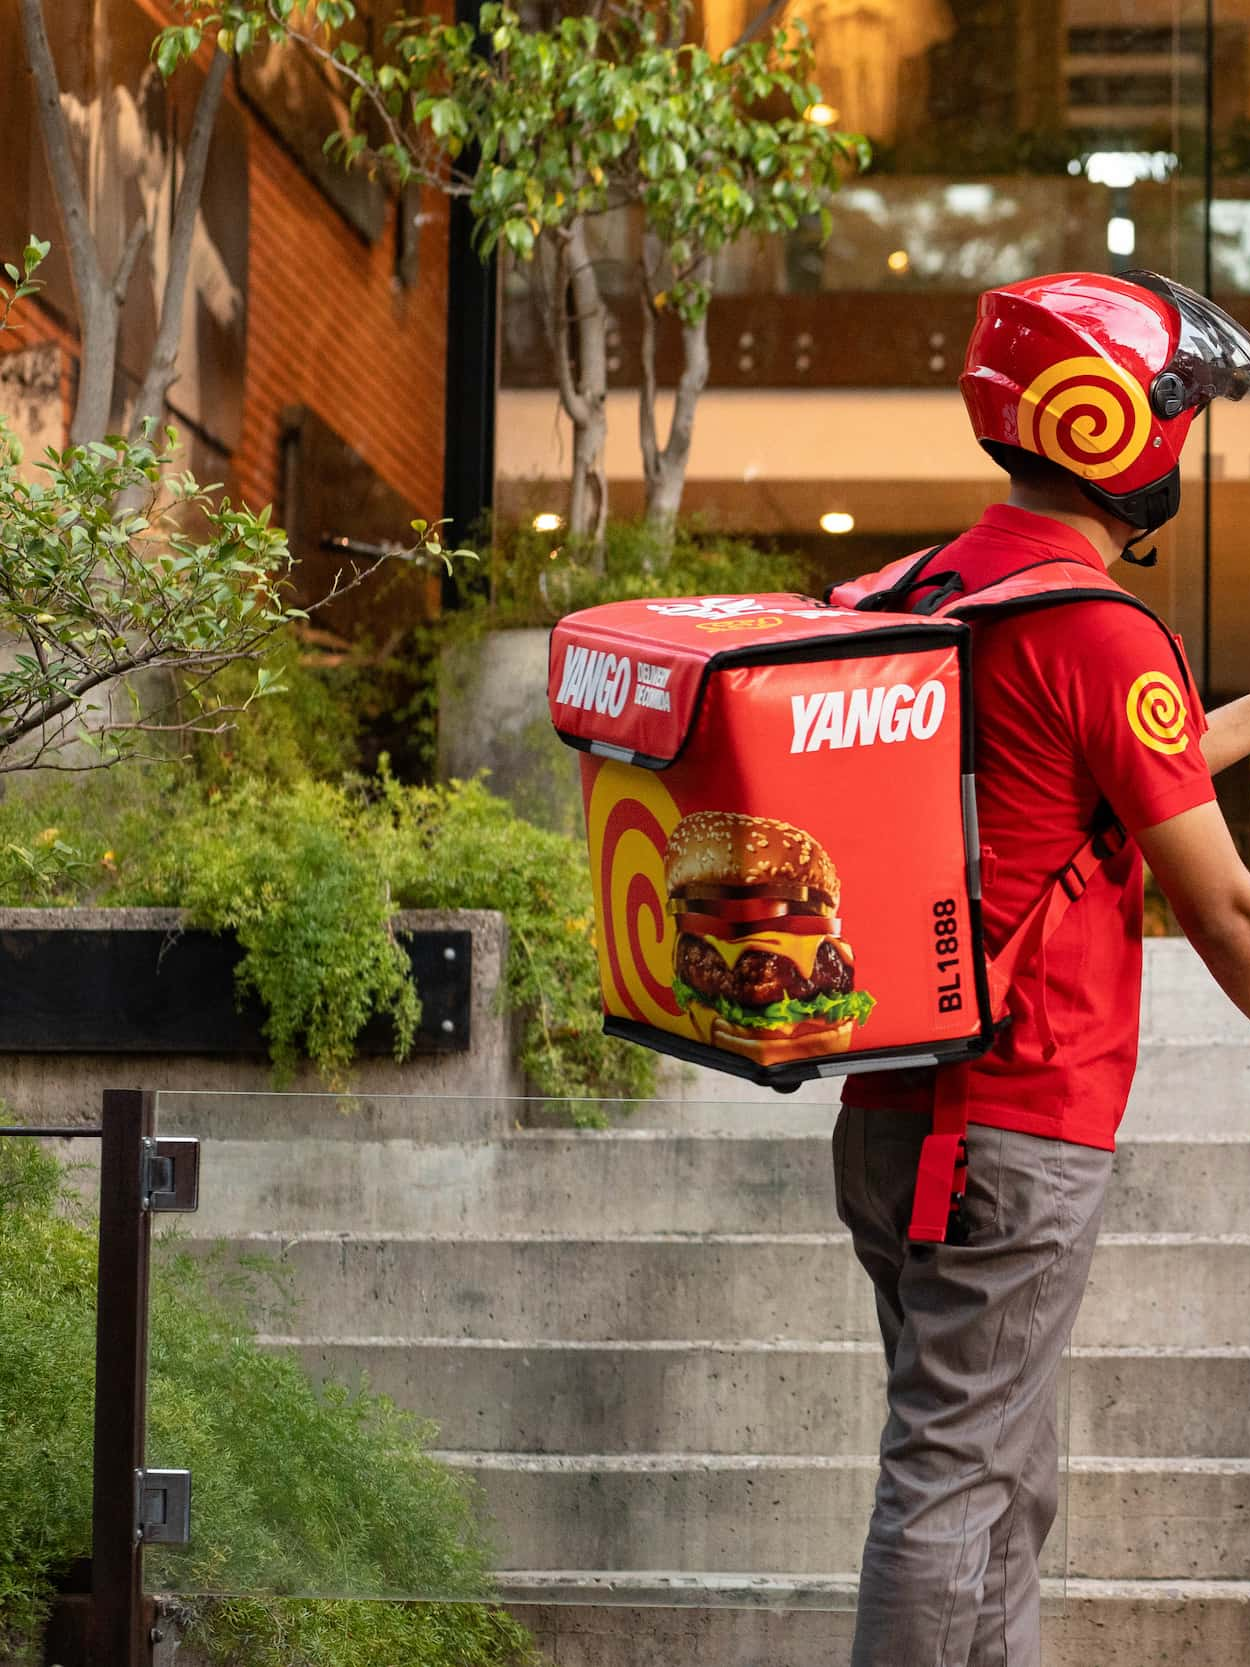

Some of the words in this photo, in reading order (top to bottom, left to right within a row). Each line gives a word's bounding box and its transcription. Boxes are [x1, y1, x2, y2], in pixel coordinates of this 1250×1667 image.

[556, 644, 632, 718] YANGO
[790, 679, 946, 754] YANGO
[933, 898, 962, 1013] BL1888
